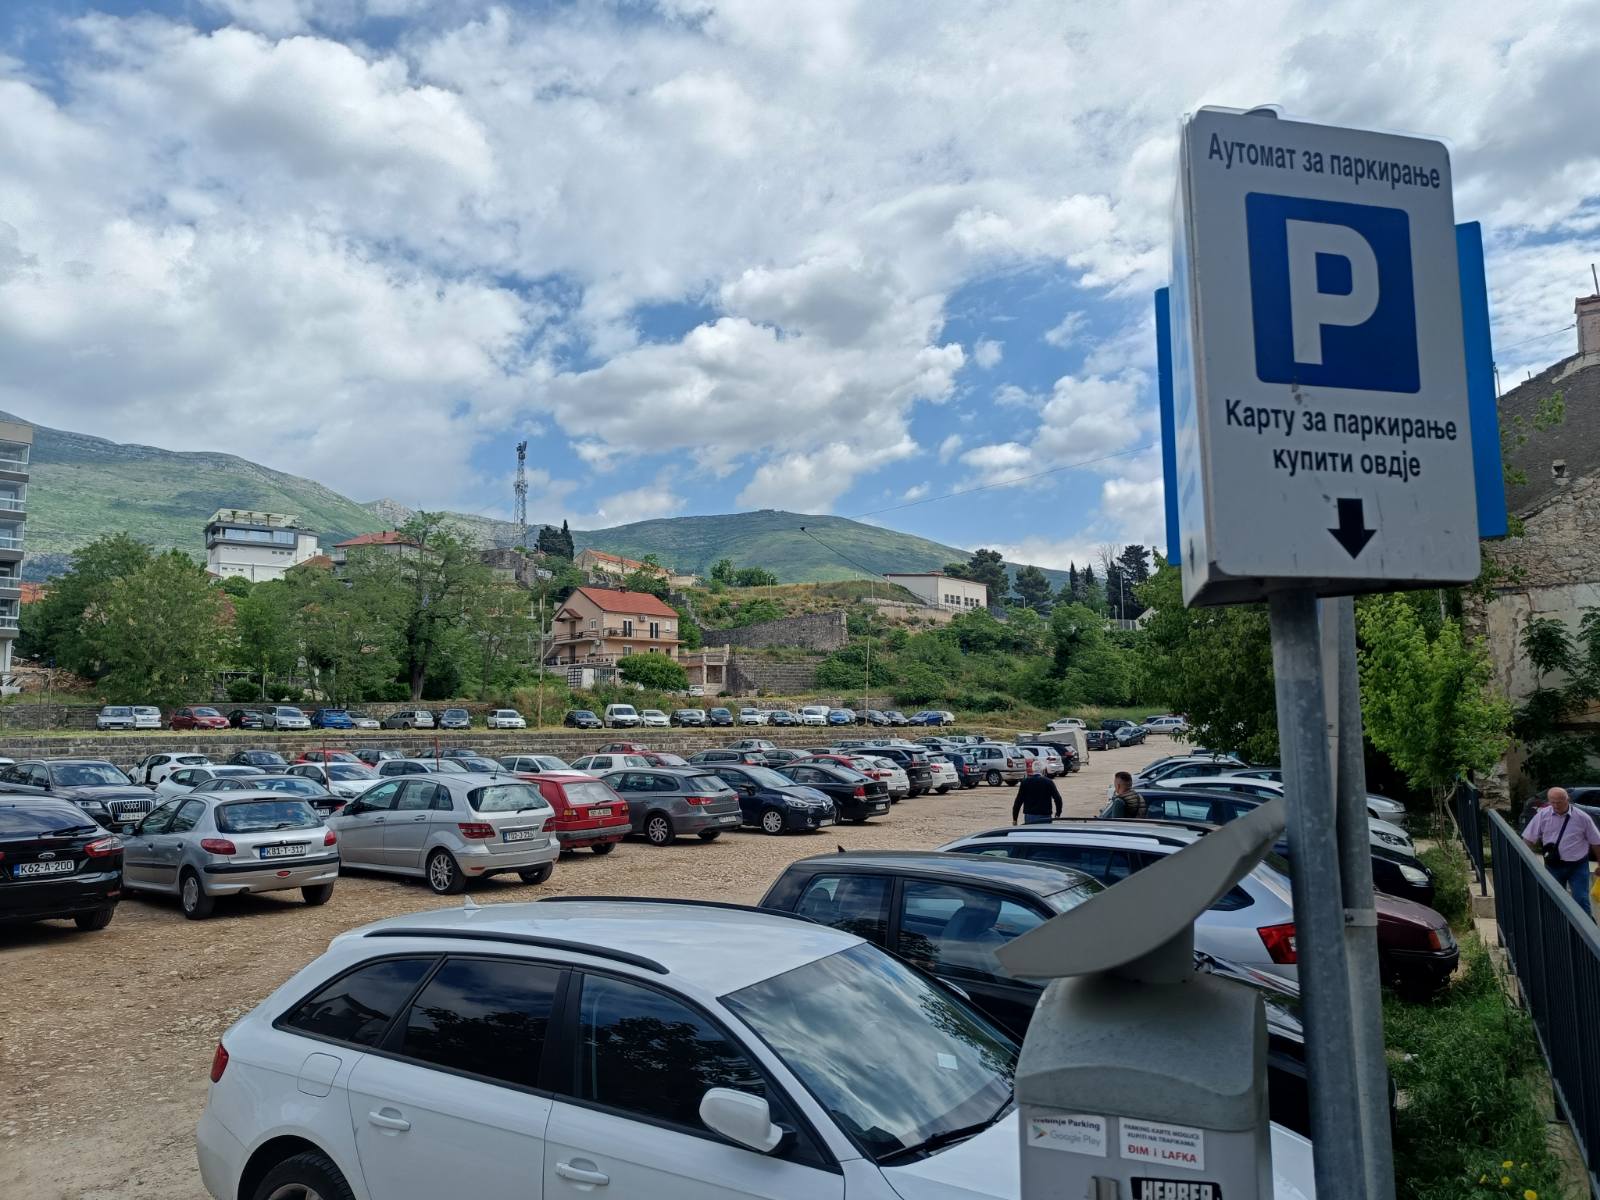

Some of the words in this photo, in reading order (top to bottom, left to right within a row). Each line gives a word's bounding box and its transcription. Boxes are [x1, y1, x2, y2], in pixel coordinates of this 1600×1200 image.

[1209, 132, 1296, 171] Аутомат
[1302, 148, 1324, 174] за
[1330, 153, 1441, 190] паркирање
[1285, 217, 1381, 366] P
[1225, 399, 1295, 438] Карту
[1302, 410, 1327, 433] за
[1334, 413, 1458, 443] паркирање
[1273, 448, 1353, 476] купити
[1360, 451, 1422, 482] овдје
[20, 861, 73, 874] K62-A-200
[1050, 1129, 1082, 1144] Google
[1083, 1133, 1102, 1147] Play
[1068, 1119, 1100, 1131] Parking
[1128, 1144, 1149, 1156] ĐIM
[1161, 1150, 1197, 1163] LAFKA
